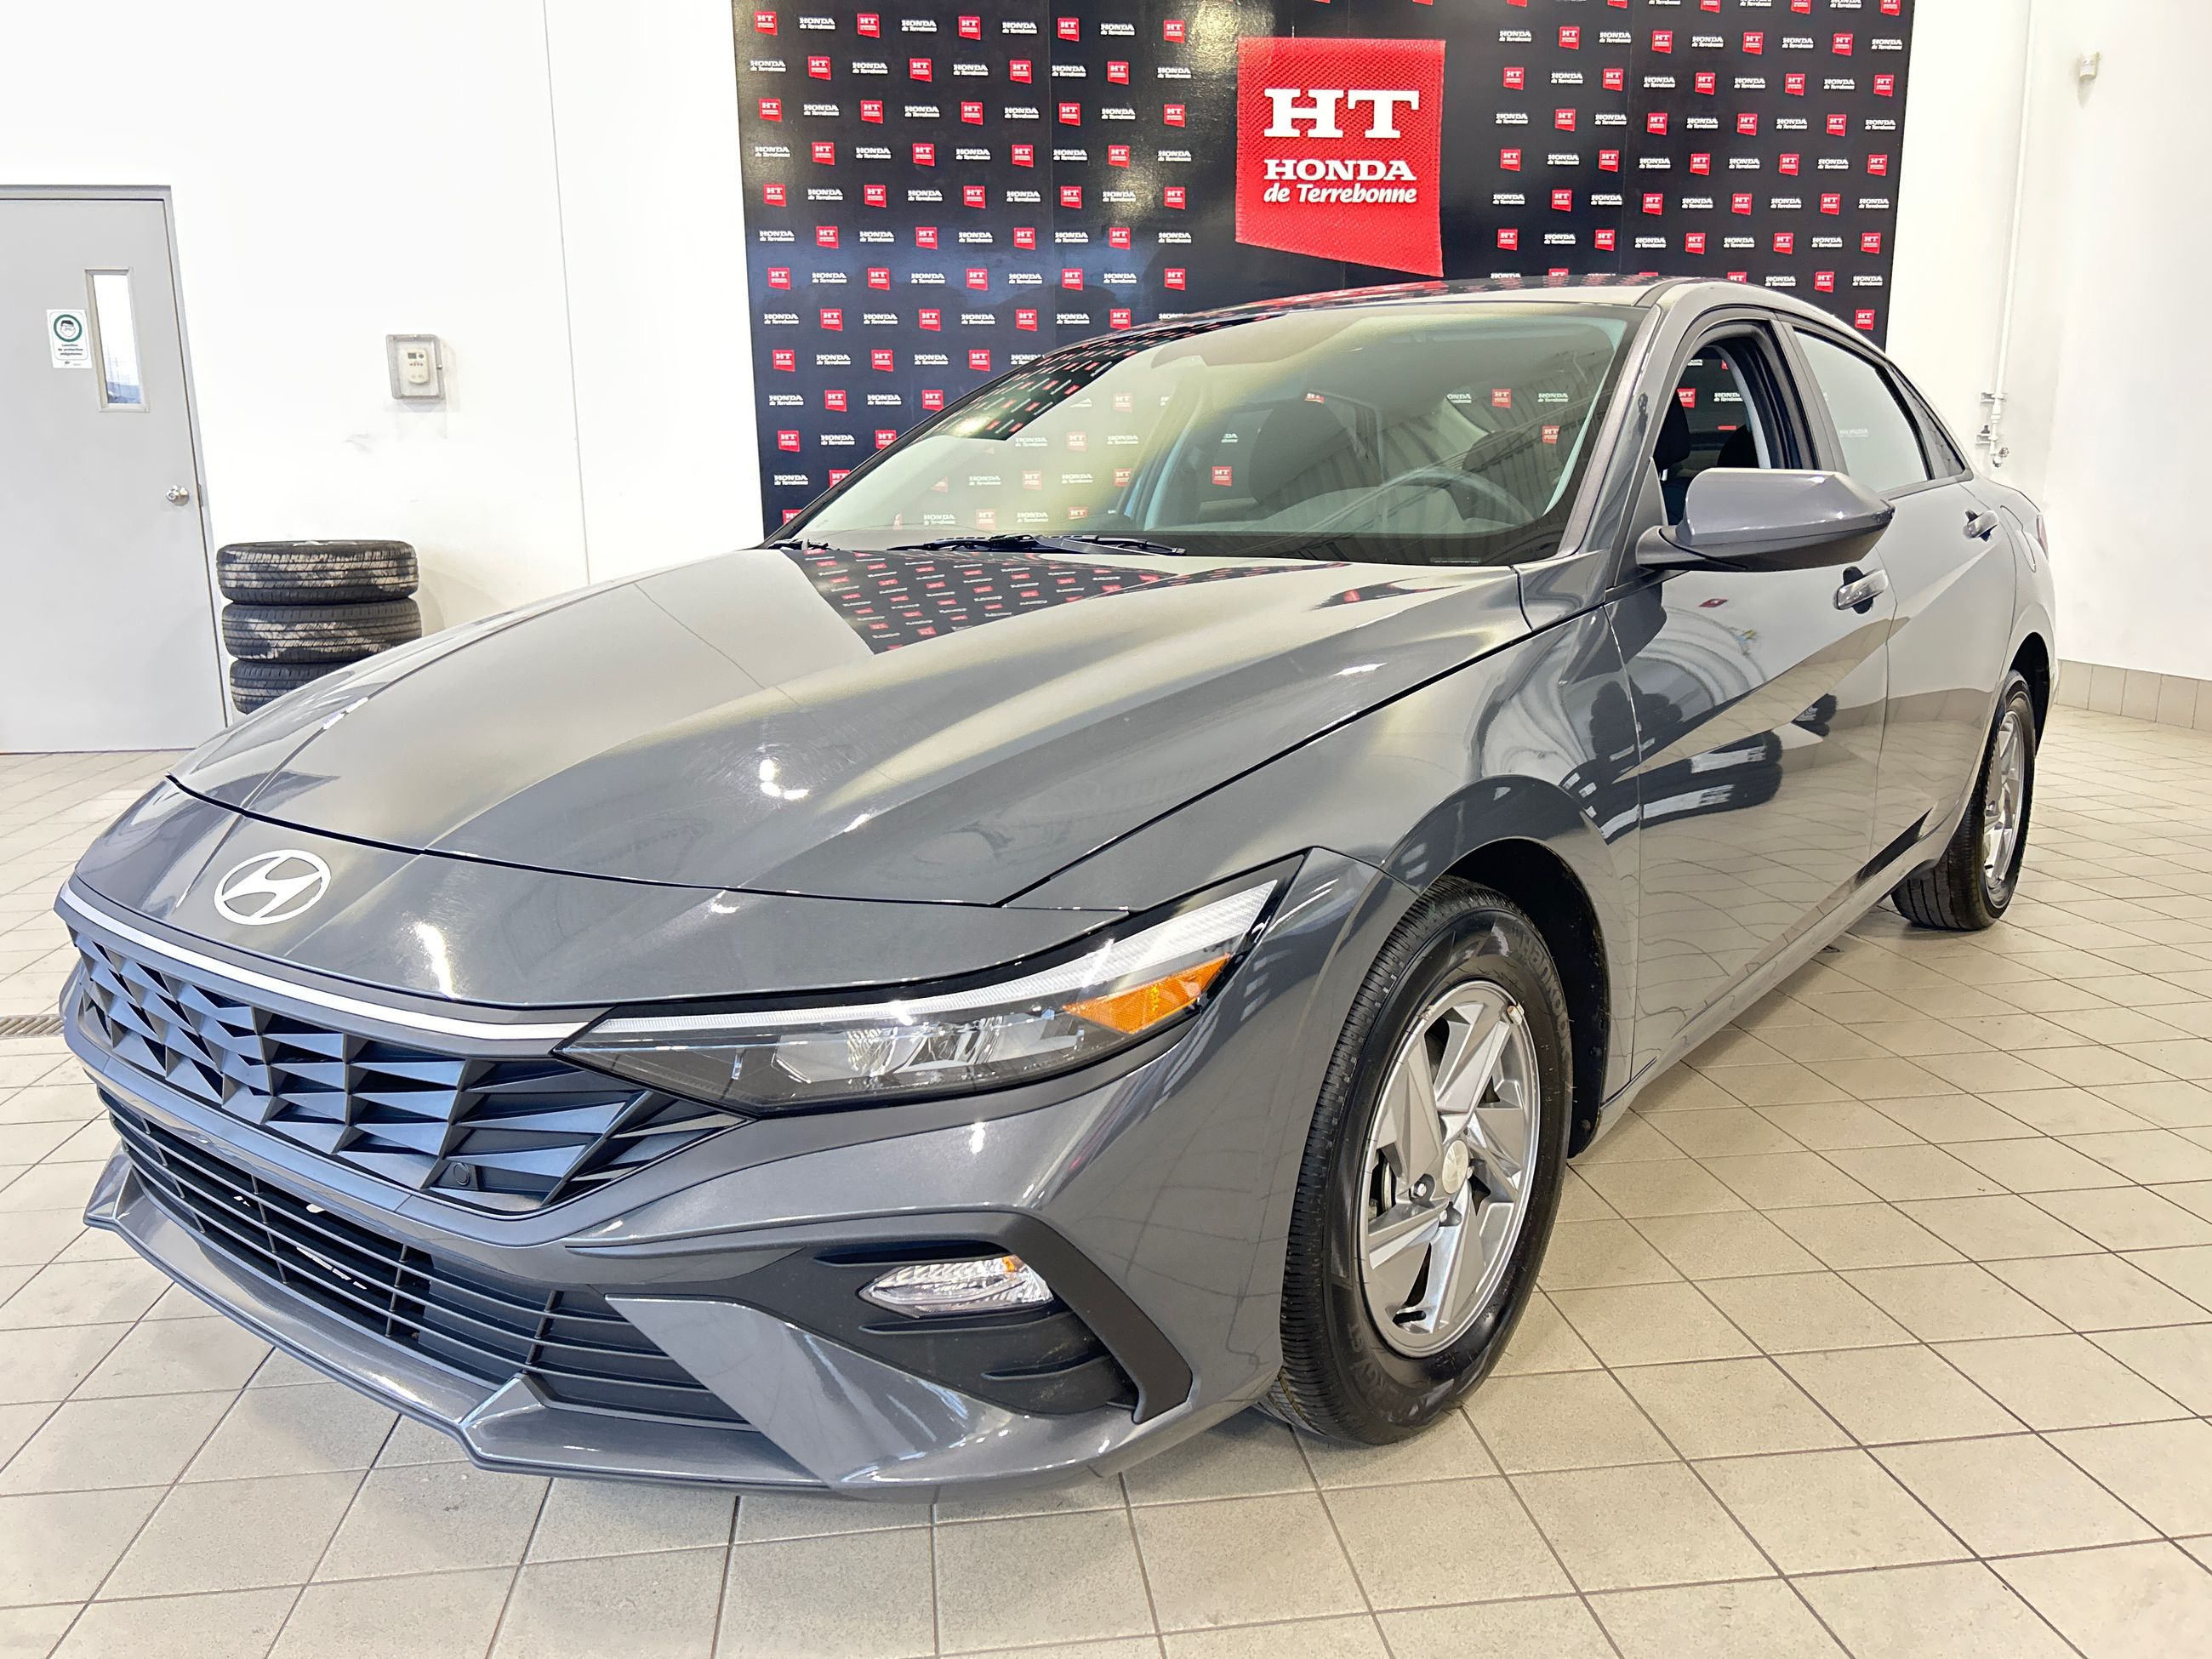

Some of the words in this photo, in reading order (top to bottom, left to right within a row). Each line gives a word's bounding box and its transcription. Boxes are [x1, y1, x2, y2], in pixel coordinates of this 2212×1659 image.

[1263, 88, 1420, 139] HT
[1263, 159, 1417, 181] HONDA
[1263, 183, 1291, 202] de
[1297, 183, 1417, 203] Terrebonne
